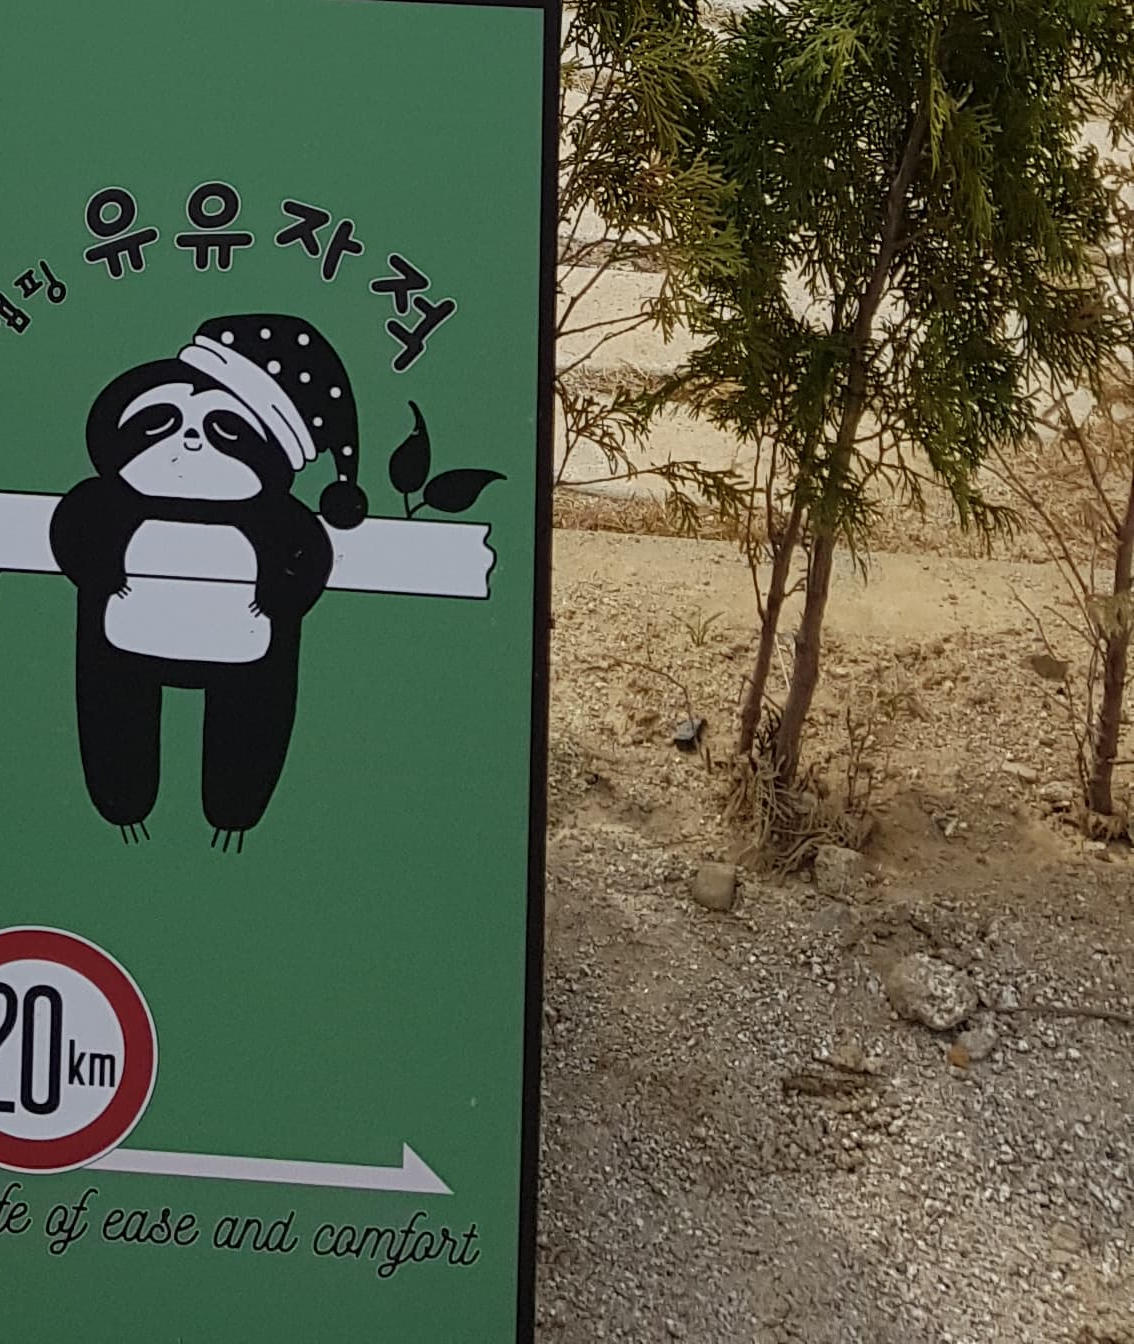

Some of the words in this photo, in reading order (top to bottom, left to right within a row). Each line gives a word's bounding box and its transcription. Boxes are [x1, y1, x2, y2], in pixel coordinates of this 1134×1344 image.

[83, 181, 458, 373] 유유자적
[45, 1188, 98, 1255] of
[102, 1208, 200, 1246] ease
[213, 1211, 298, 1254] and
[312, 1212, 482, 1279] comfort
